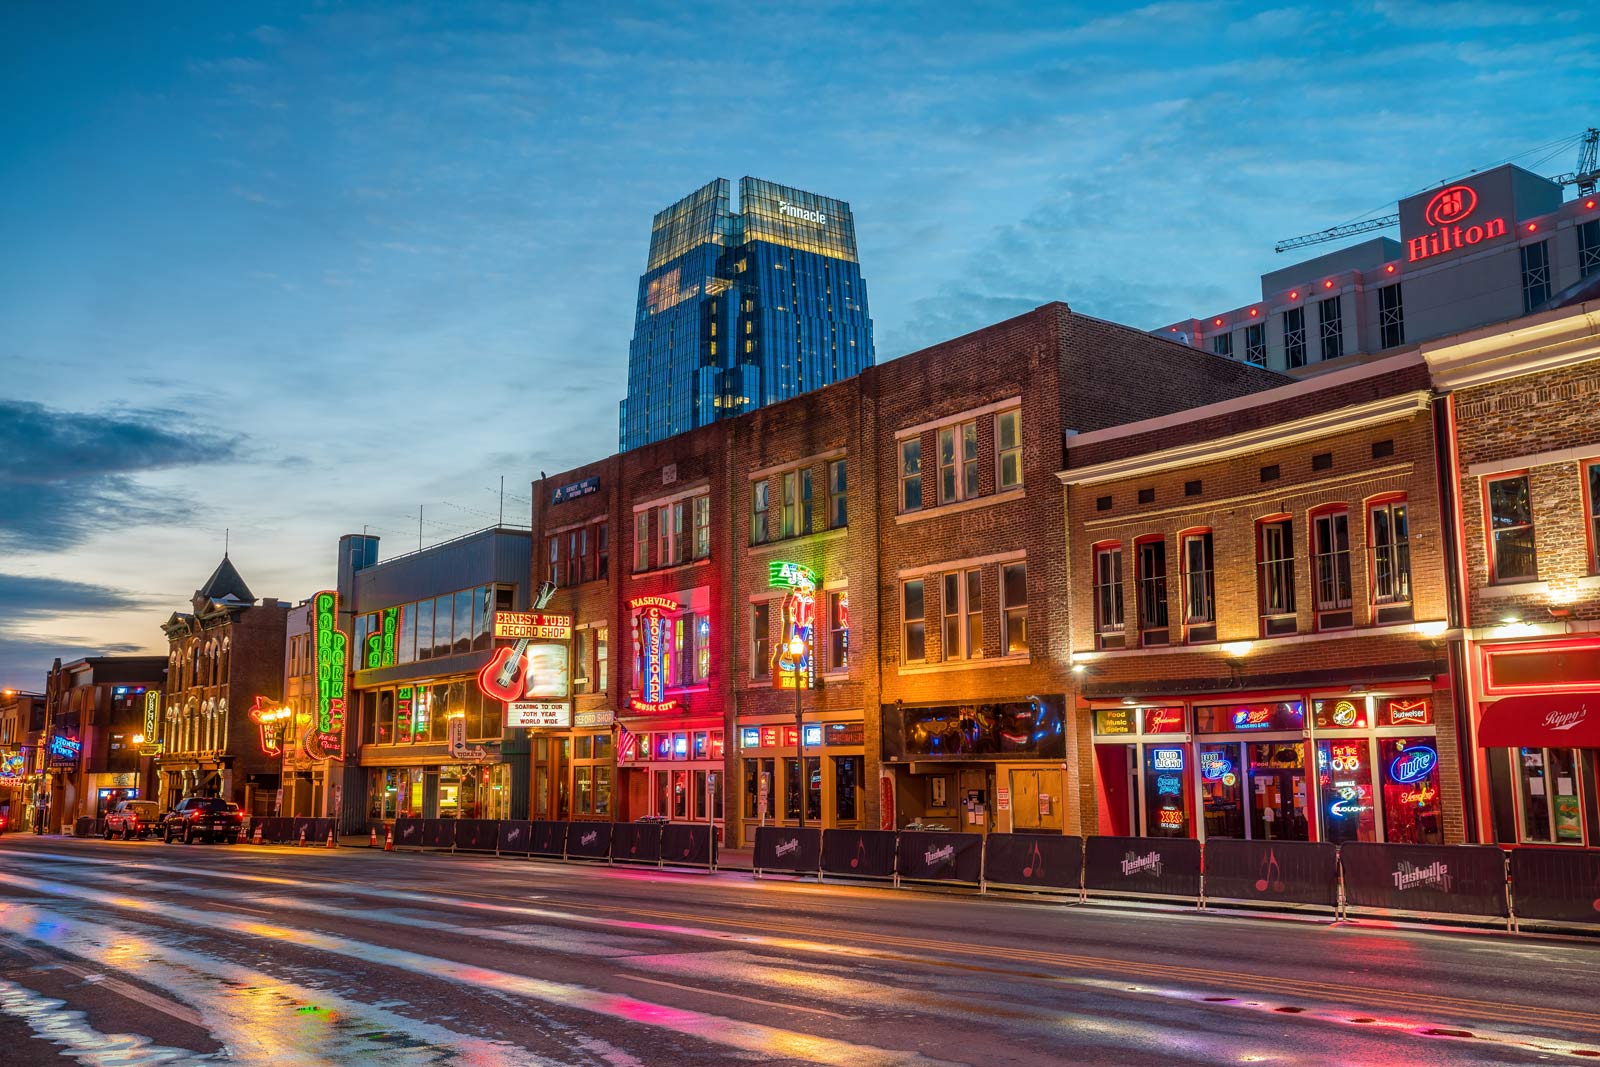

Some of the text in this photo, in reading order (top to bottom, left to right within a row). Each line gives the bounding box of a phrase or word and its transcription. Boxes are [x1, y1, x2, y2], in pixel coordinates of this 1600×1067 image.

[779, 200, 826, 225] Pinnacle
[1407, 217, 1506, 263] Hilton
[630, 596, 677, 611] NASHVILLE
[496, 612, 571, 626] ERNEST TUBB
[501, 625, 566, 638] RECORD SHOP
[318, 594, 333, 733] PARADISE
[649, 607, 661, 703] CROSSROADS
[331, 633, 345, 699] PARK
[1393, 707, 1425, 719] Budweiser
[1541, 704, 1587, 728] Rippy's
[51, 742, 74, 758] TONK
[55, 735, 80, 751] HONKY
[1156, 758, 1182, 768] LIGHT
[1158, 751, 1178, 760] BUD
[1400, 754, 1431, 781] Lite
[1121, 851, 1160, 876] Nashville
[1391, 861, 1448, 891] Nashville
[1402, 881, 1421, 890] MUSIC
